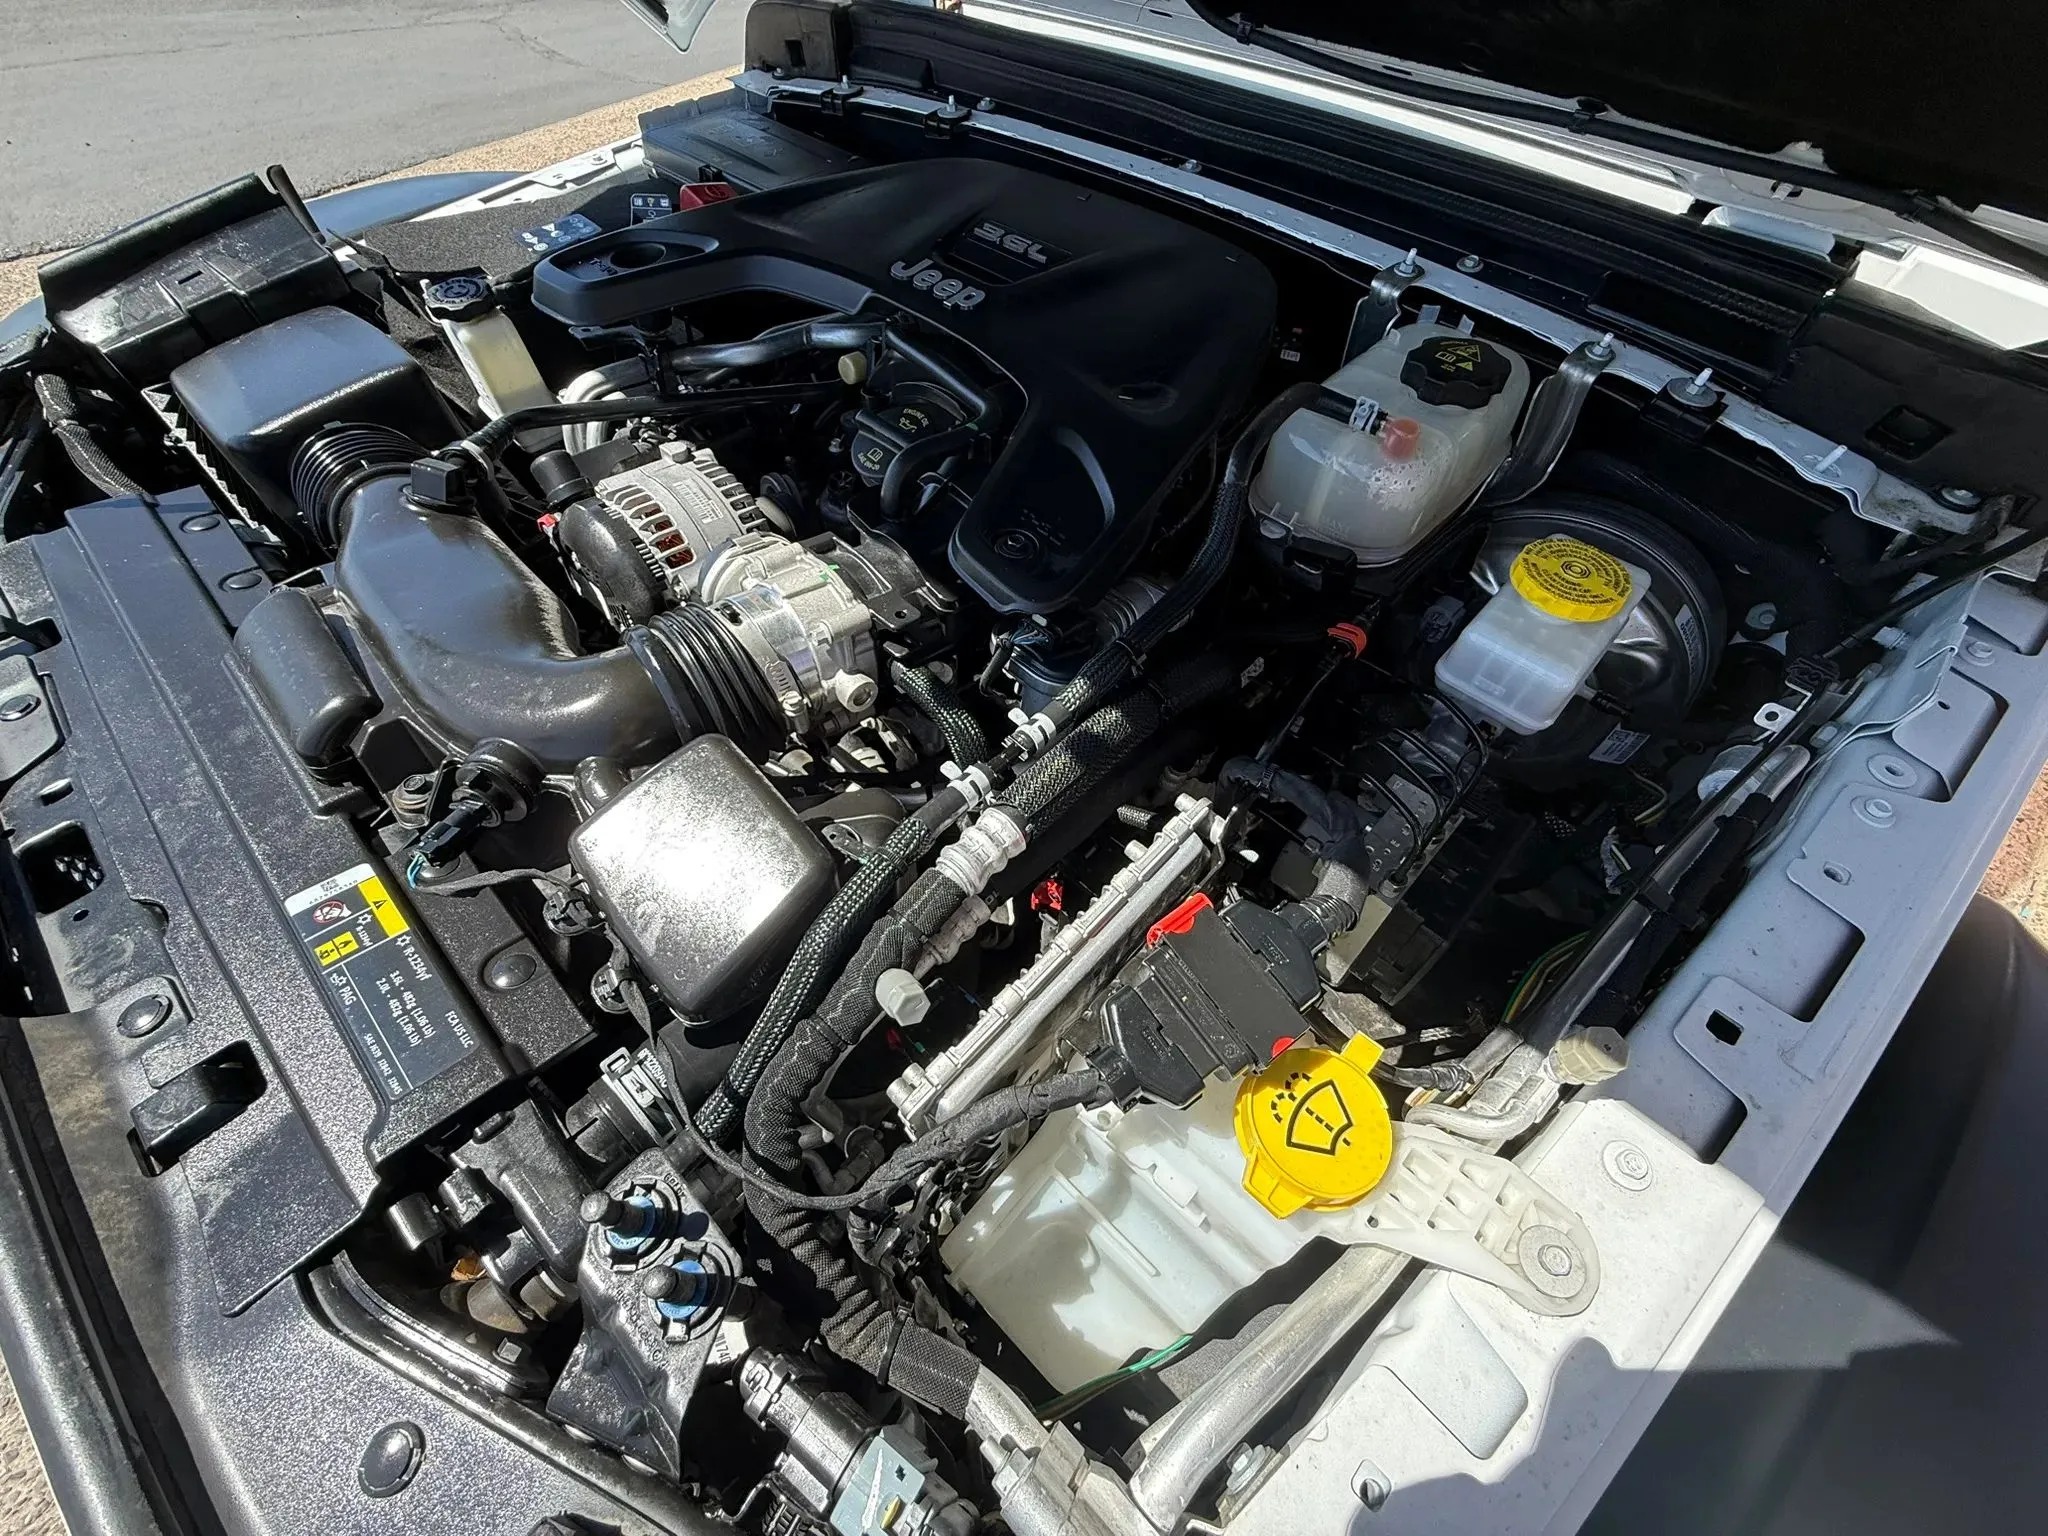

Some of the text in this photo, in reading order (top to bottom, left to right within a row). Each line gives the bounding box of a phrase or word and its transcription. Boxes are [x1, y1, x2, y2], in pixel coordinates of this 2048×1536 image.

[890, 258, 986, 310] Jeep
[903, 408, 925, 420] ENGINE
[402, 945, 432, 983] R-1234yf
[339, 985, 357, 1006] PAG
[375, 977, 391, 995] 2.0L
[386, 998, 404, 1018] 482g
[396, 1015, 415, 1036] (1.06
[406, 1032, 422, 1047] Lb)
[389, 969, 405, 987] 3.6L
[399, 990, 418, 1010] 482g
[410, 1007, 429, 1028] (1.06
[421, 1024, 436, 1039] Lb)
[363, 1033, 376, 1047] SAE
[445, 1010, 474, 1049] FCA US LLC
